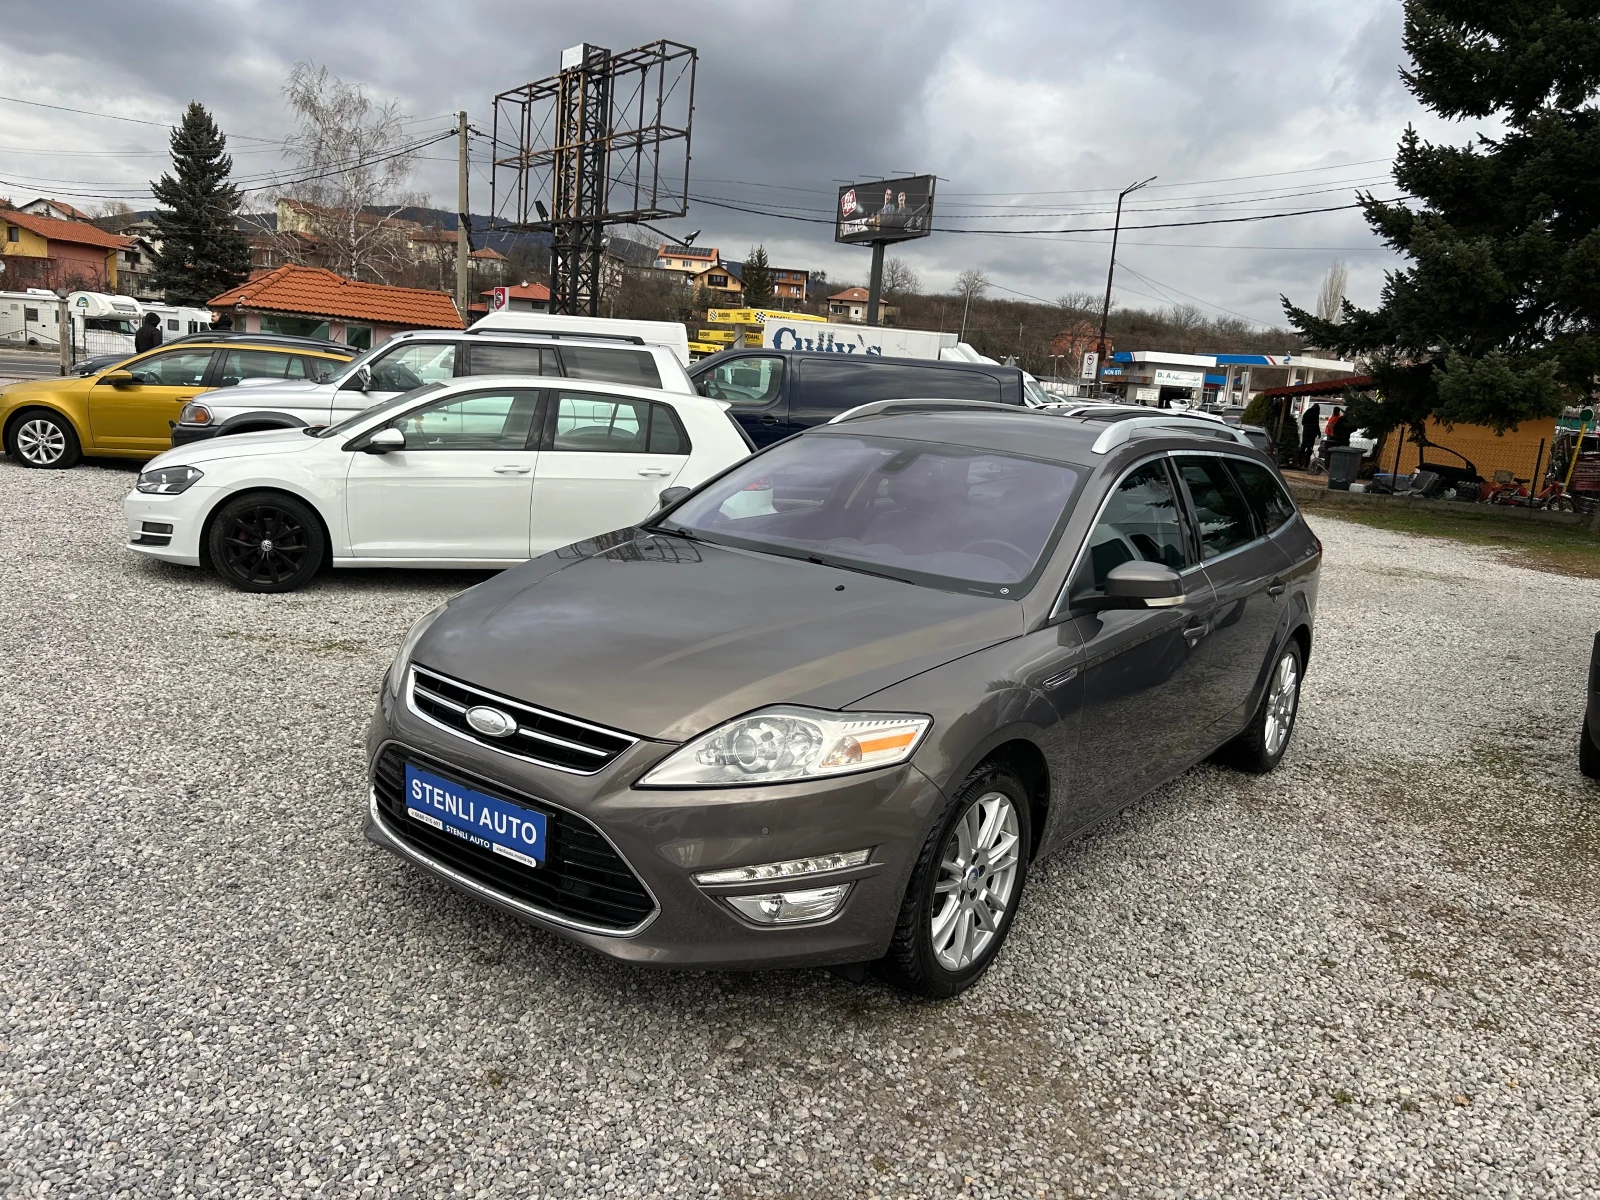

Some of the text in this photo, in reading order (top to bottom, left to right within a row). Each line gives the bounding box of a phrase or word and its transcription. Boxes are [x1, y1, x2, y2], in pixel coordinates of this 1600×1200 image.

[411, 778, 537, 845] STENLI AUTO
[446, 824, 490, 848] STENLI AUTO
